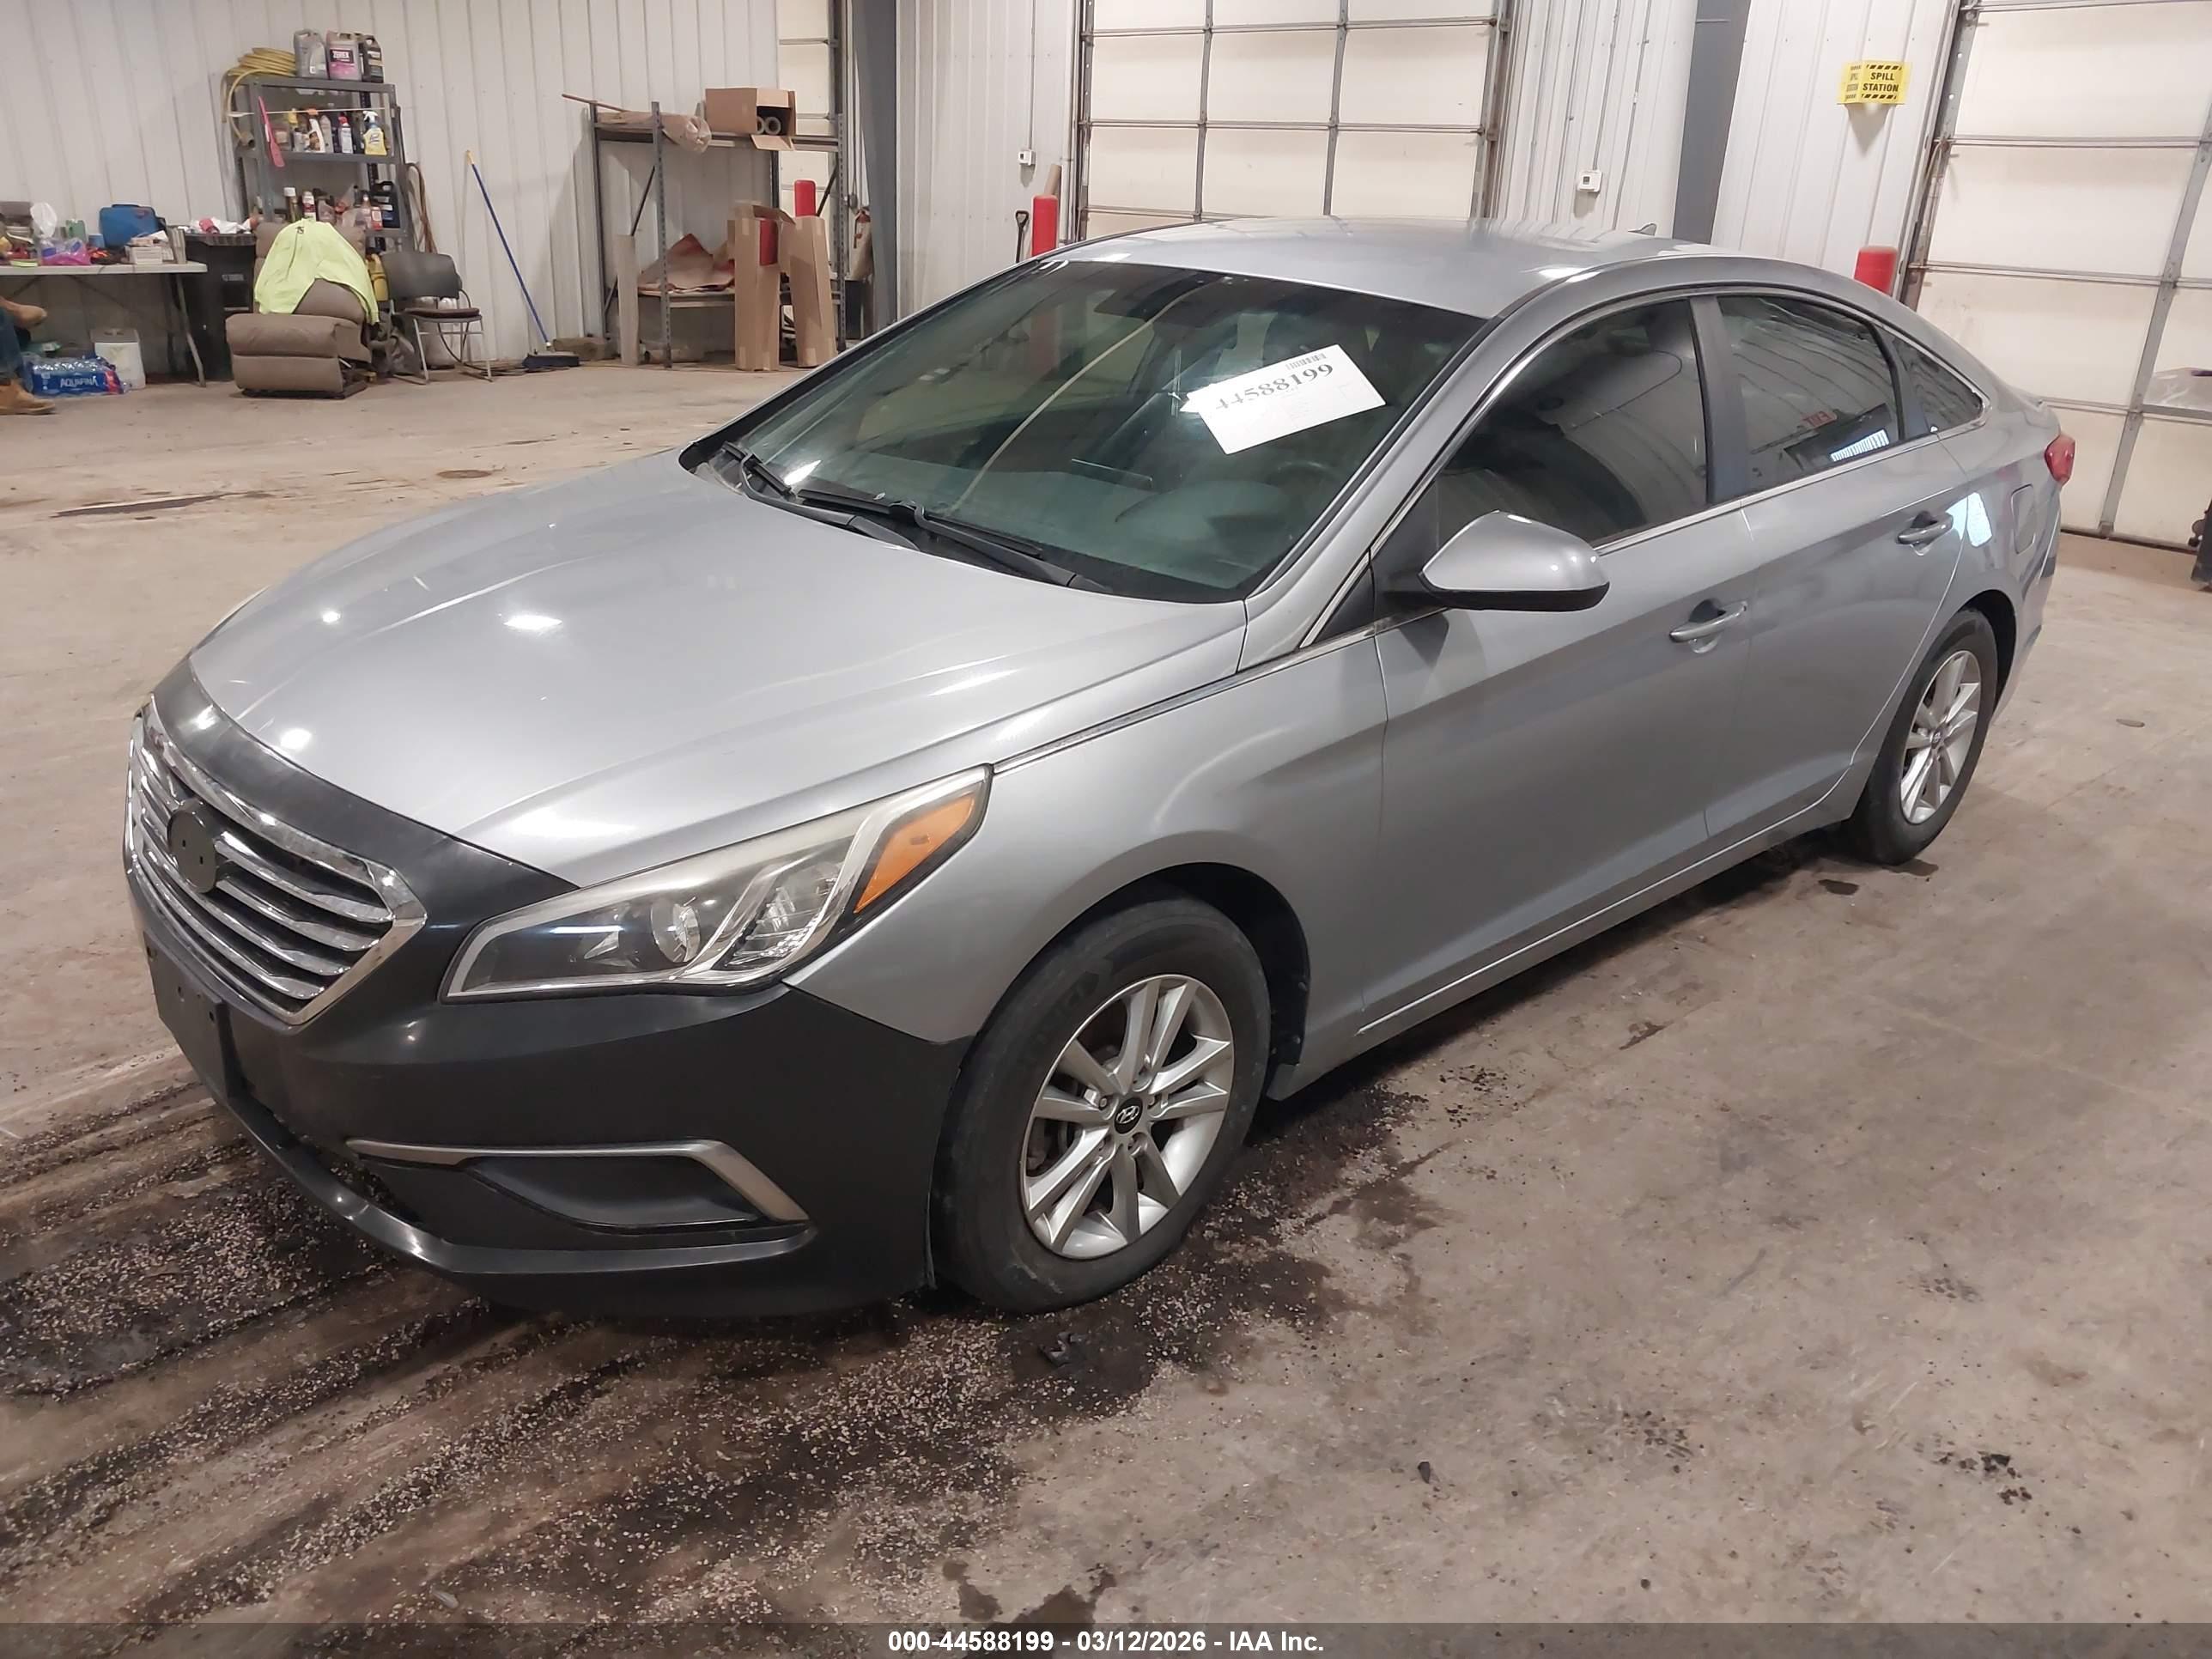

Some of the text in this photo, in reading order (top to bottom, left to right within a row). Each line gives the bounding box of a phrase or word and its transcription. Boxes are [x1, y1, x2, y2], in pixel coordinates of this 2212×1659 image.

[1870, 72, 1894, 81] SPILL
[1863, 82, 1899, 92] STATION
[1215, 363, 1334, 410] 44588199
